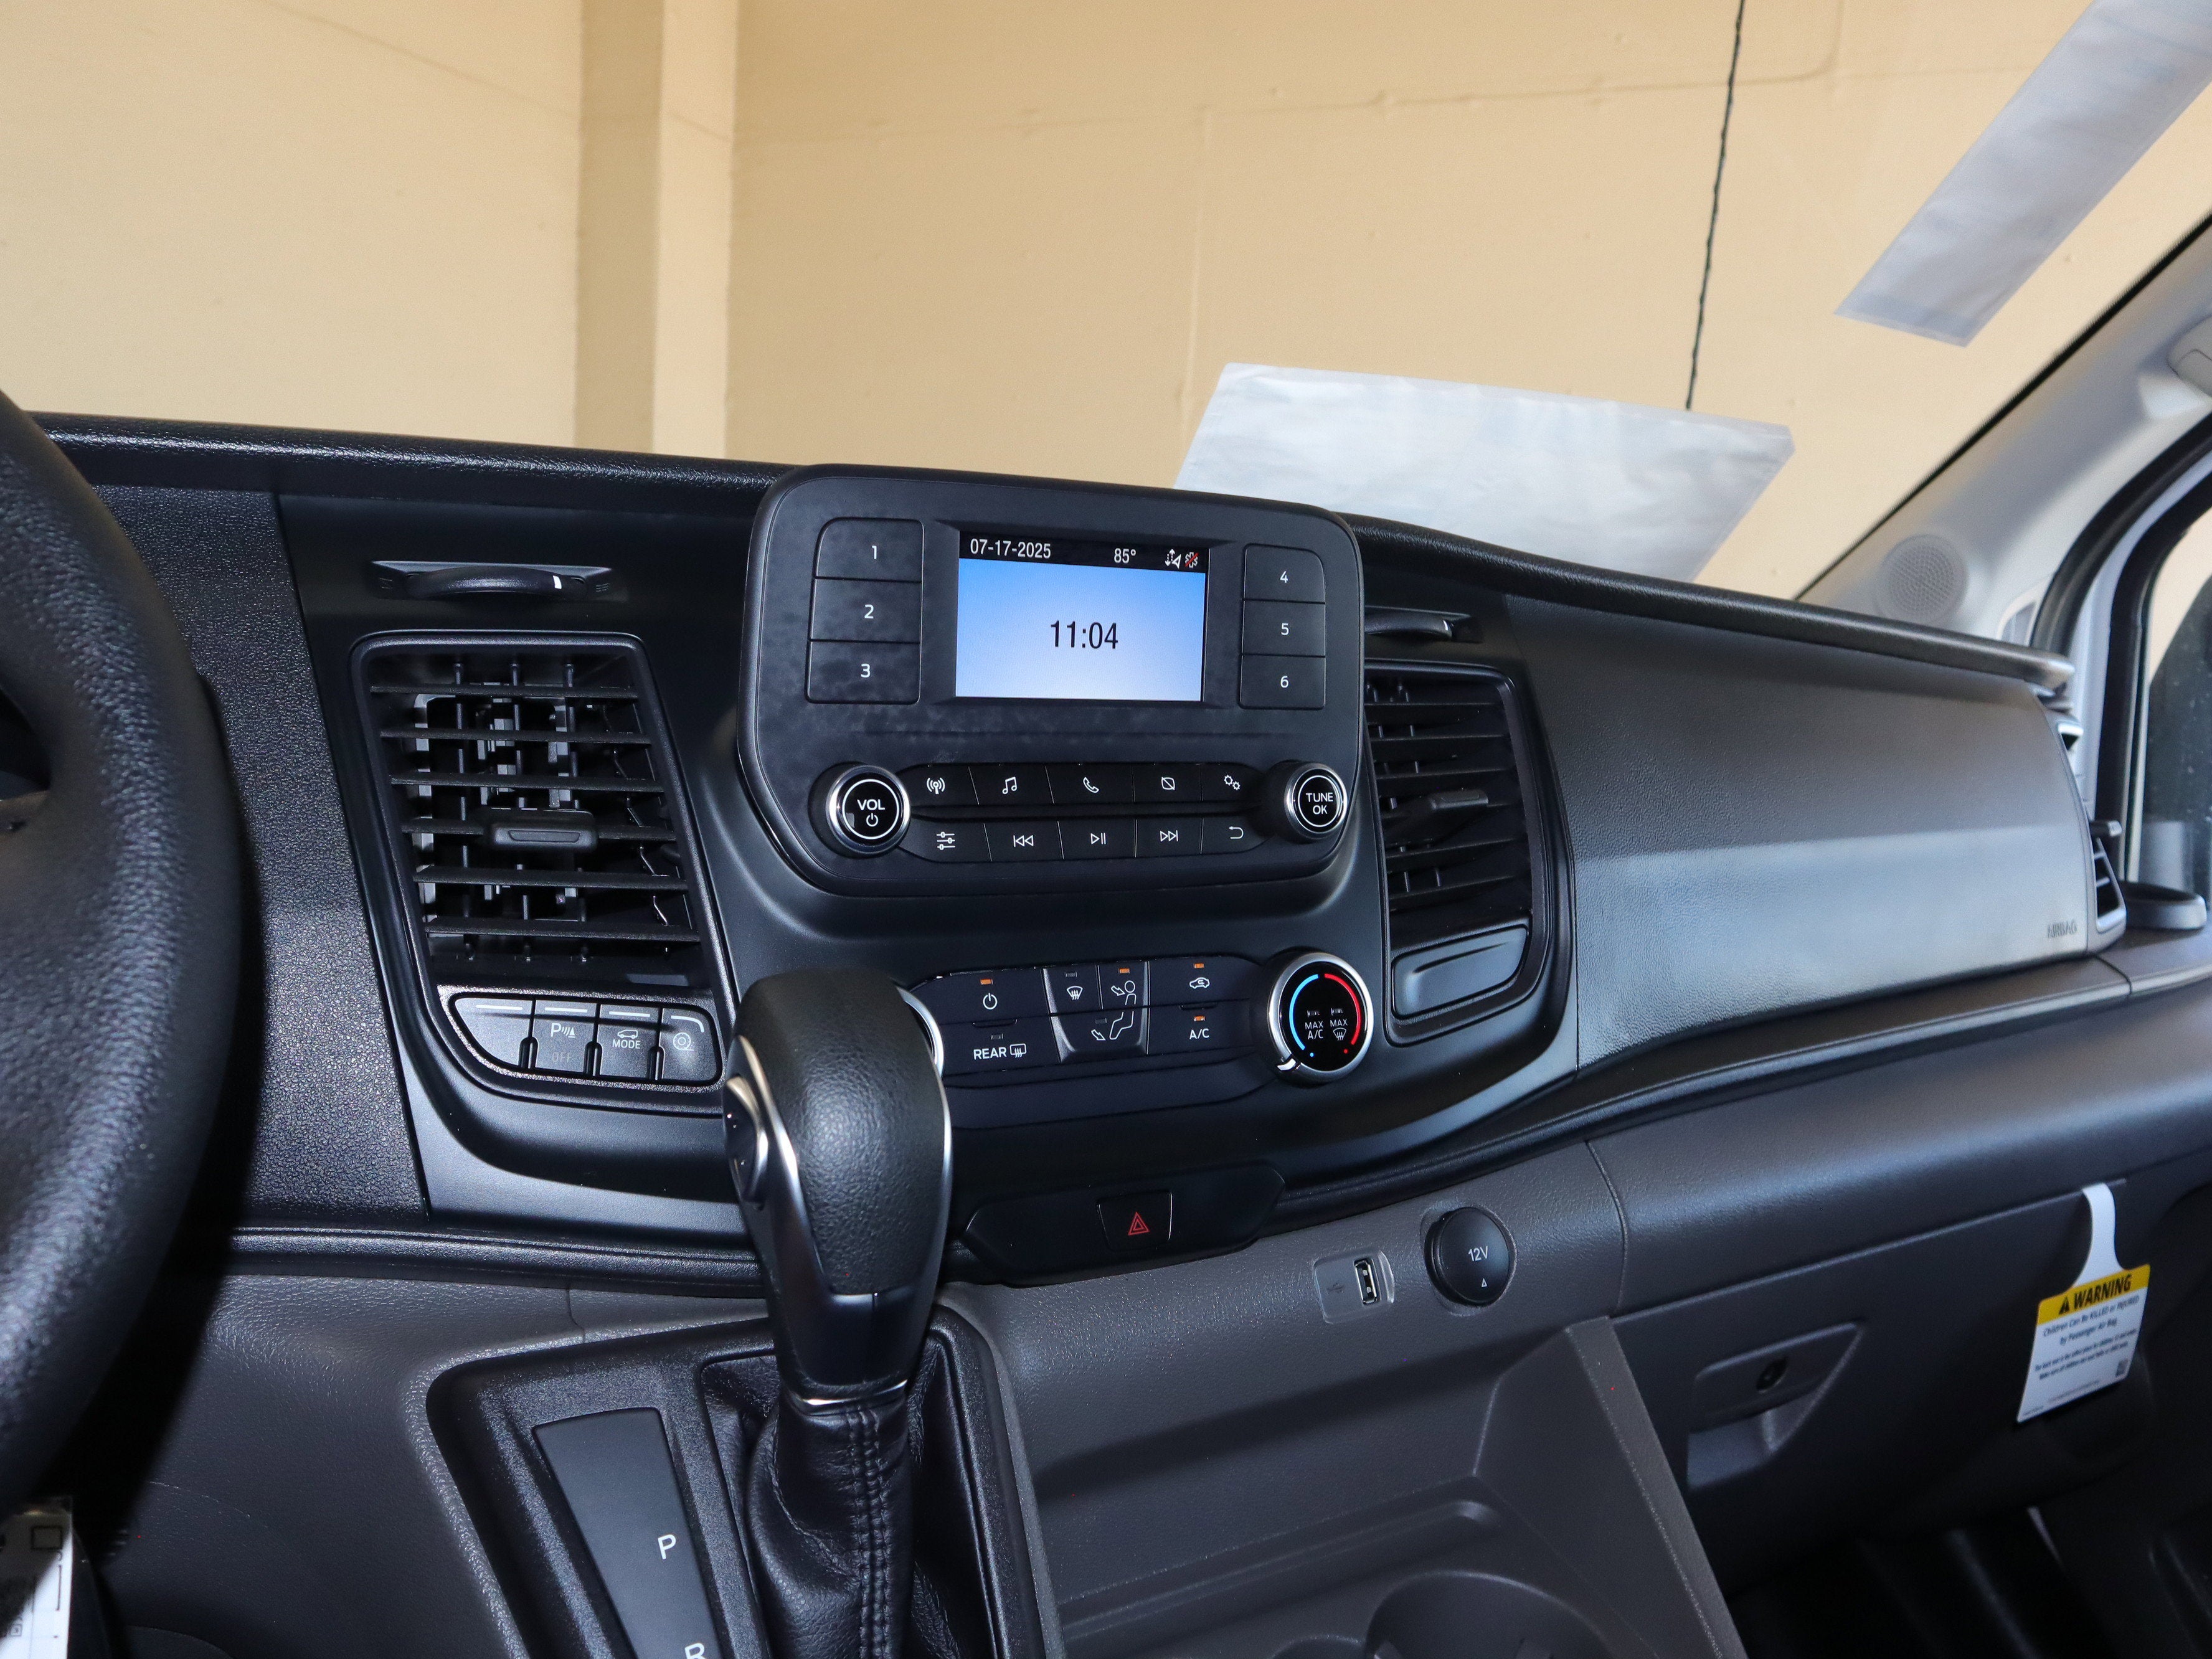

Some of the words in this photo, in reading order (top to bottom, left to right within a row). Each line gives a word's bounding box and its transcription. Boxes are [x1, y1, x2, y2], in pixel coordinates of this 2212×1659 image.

[871, 545, 877, 560] 1
[969, 538, 1051, 560] 07-17-2025
[1113, 547, 1137, 564] 85°
[1280, 570, 1289, 584] 4
[864, 604, 874, 619] 2
[1050, 620, 1118, 650] 11:04
[1281, 623, 1289, 636] 5
[860, 663, 871, 678] 3
[1280, 675, 1289, 688] 6
[856, 798, 886, 811] VOL
[1305, 792, 1334, 803] TUNE
[1312, 805, 1328, 815] OK
[2048, 919, 2077, 938] AIRBAG
[1305, 1021, 1324, 1030] MAX
[1330, 1018, 1348, 1028] MAX
[1189, 1028, 1210, 1040] A/C
[1307, 1029, 1324, 1040] A/C
[612, 1039, 641, 1050] MODE
[552, 1051, 572, 1064] OFF
[973, 1046, 1007, 1060] REAR
[1468, 1245, 1488, 1262] 12V
[2074, 1274, 2132, 1309] WARNING
[657, 1534, 676, 1560] P
[684, 1643, 706, 1659] R
